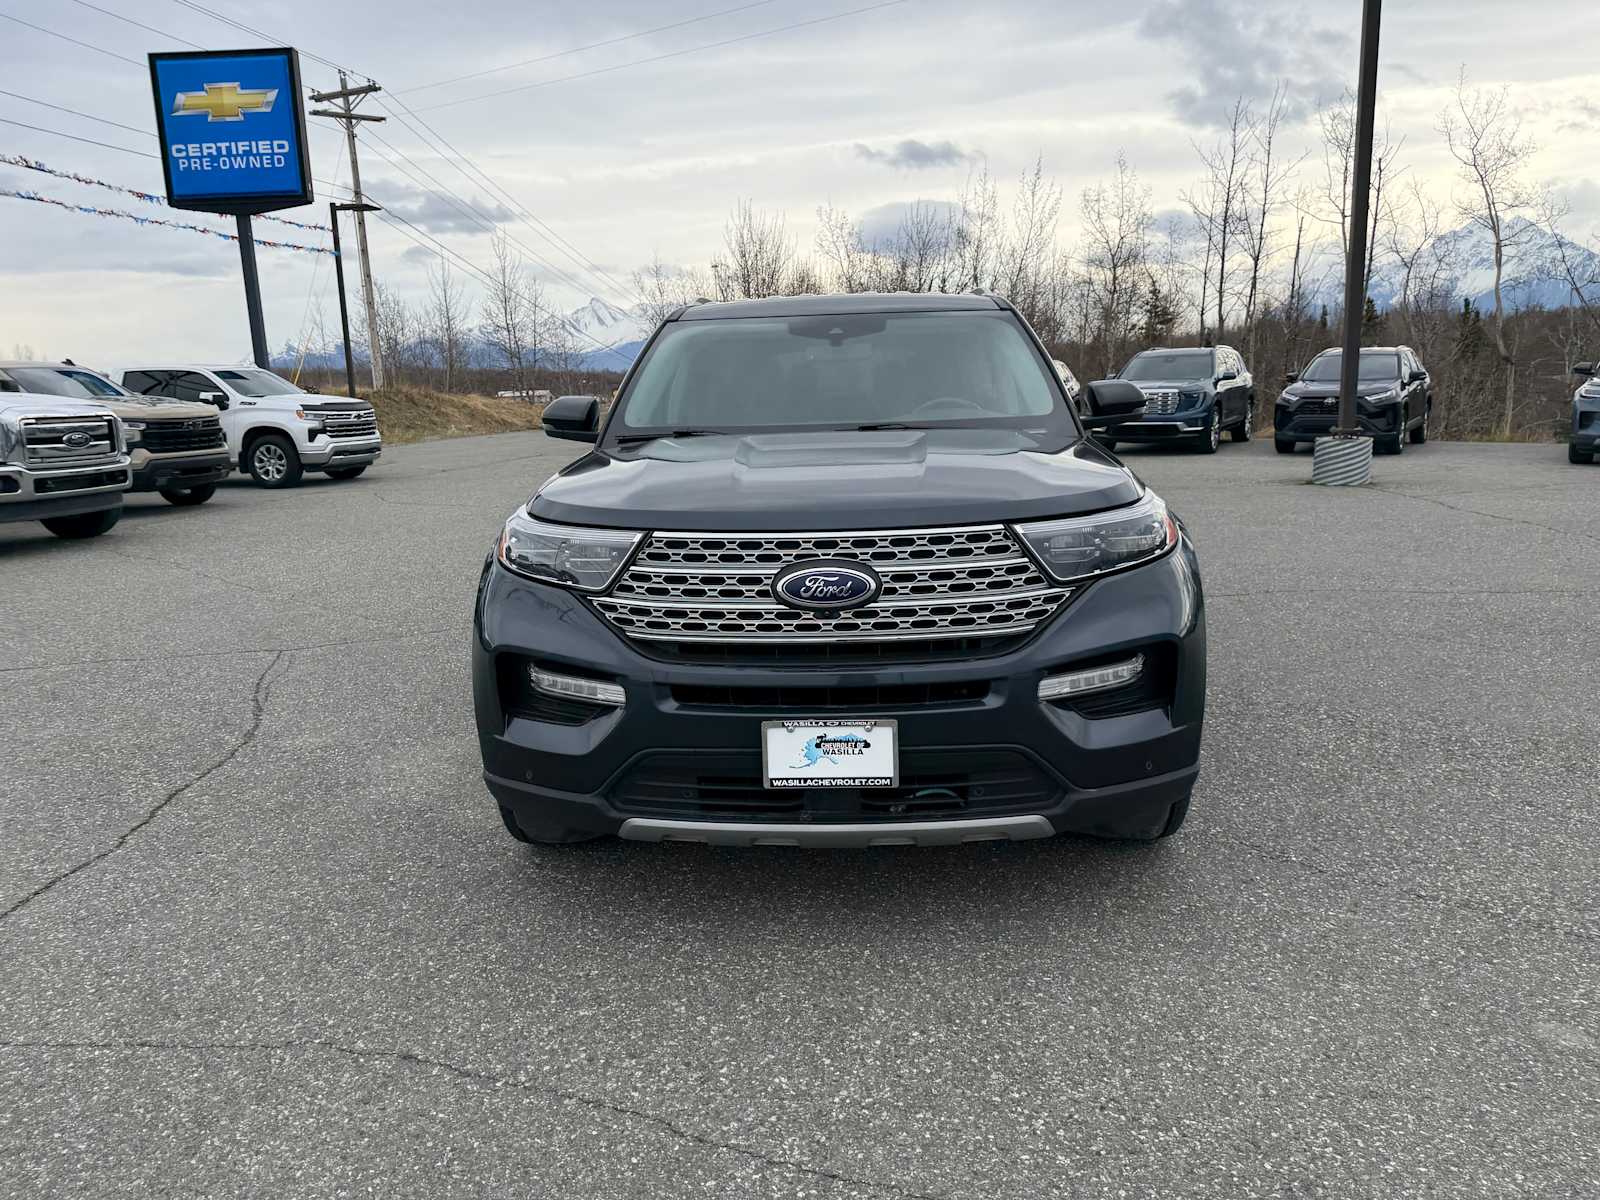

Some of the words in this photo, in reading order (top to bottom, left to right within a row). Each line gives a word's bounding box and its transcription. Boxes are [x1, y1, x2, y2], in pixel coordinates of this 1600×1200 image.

[171, 140, 289, 158] CERTIFIED
[178, 155, 285, 171] PRE-OWNED
[800, 575, 853, 598] Ford
[822, 748, 864, 756] WASILLA
[771, 778, 891, 787] WASILLACHEVROLET.COM
